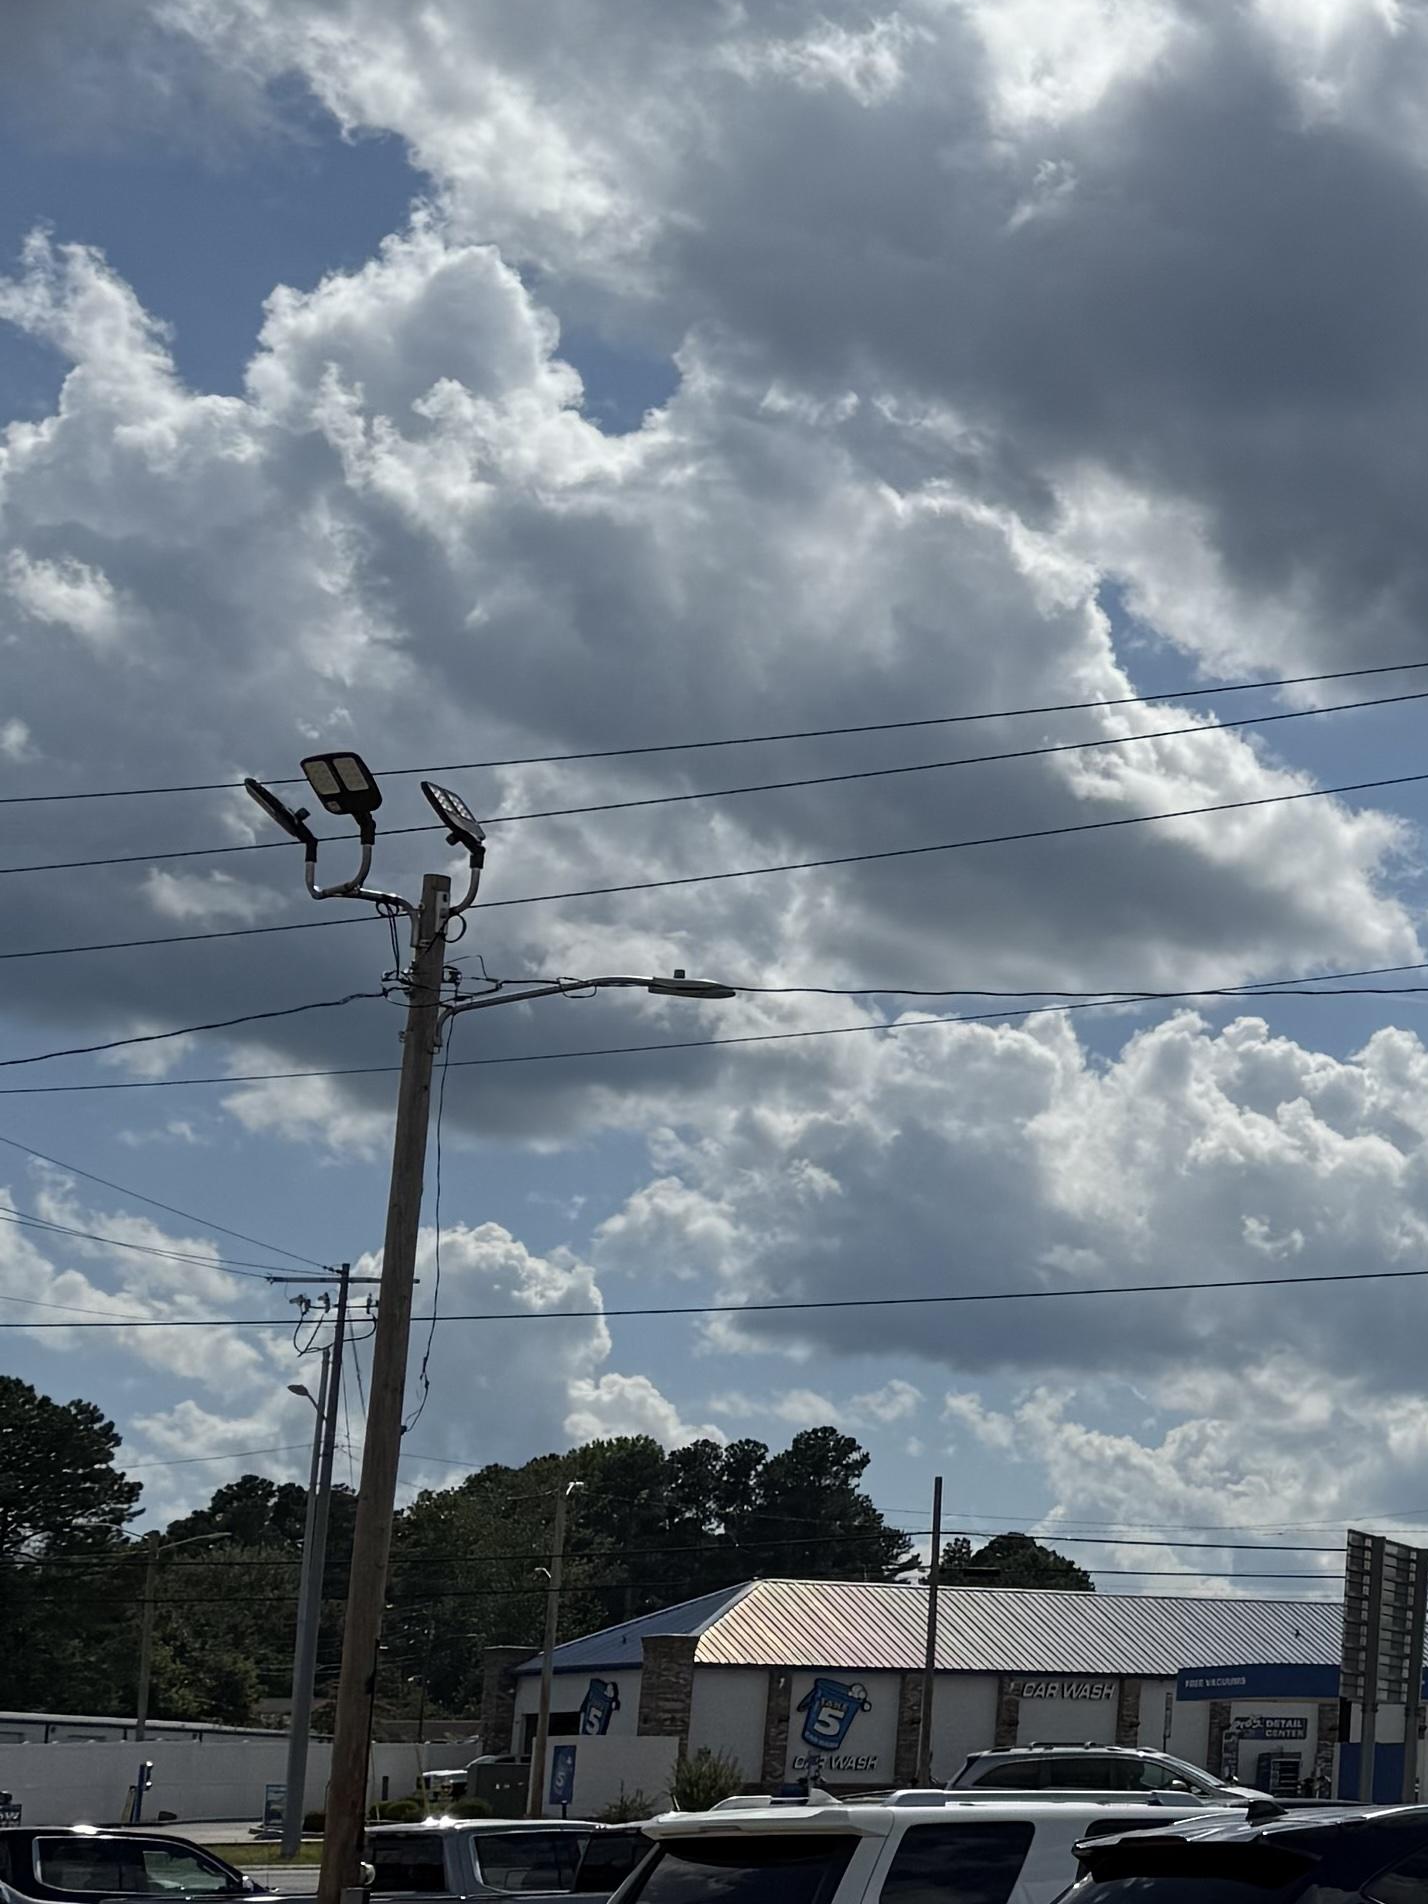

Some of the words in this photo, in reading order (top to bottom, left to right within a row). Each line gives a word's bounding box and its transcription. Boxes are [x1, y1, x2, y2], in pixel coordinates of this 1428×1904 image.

[1022, 1682, 1059, 1698] CAR
[1061, 1683, 1116, 1699] WASH
[585, 1706, 603, 1735] 5
[813, 1706, 846, 1736] 5
[1264, 1718, 1303, 1729] DETAIL
[793, 1756, 827, 1769] CR
[830, 1756, 878, 1770] WASH
